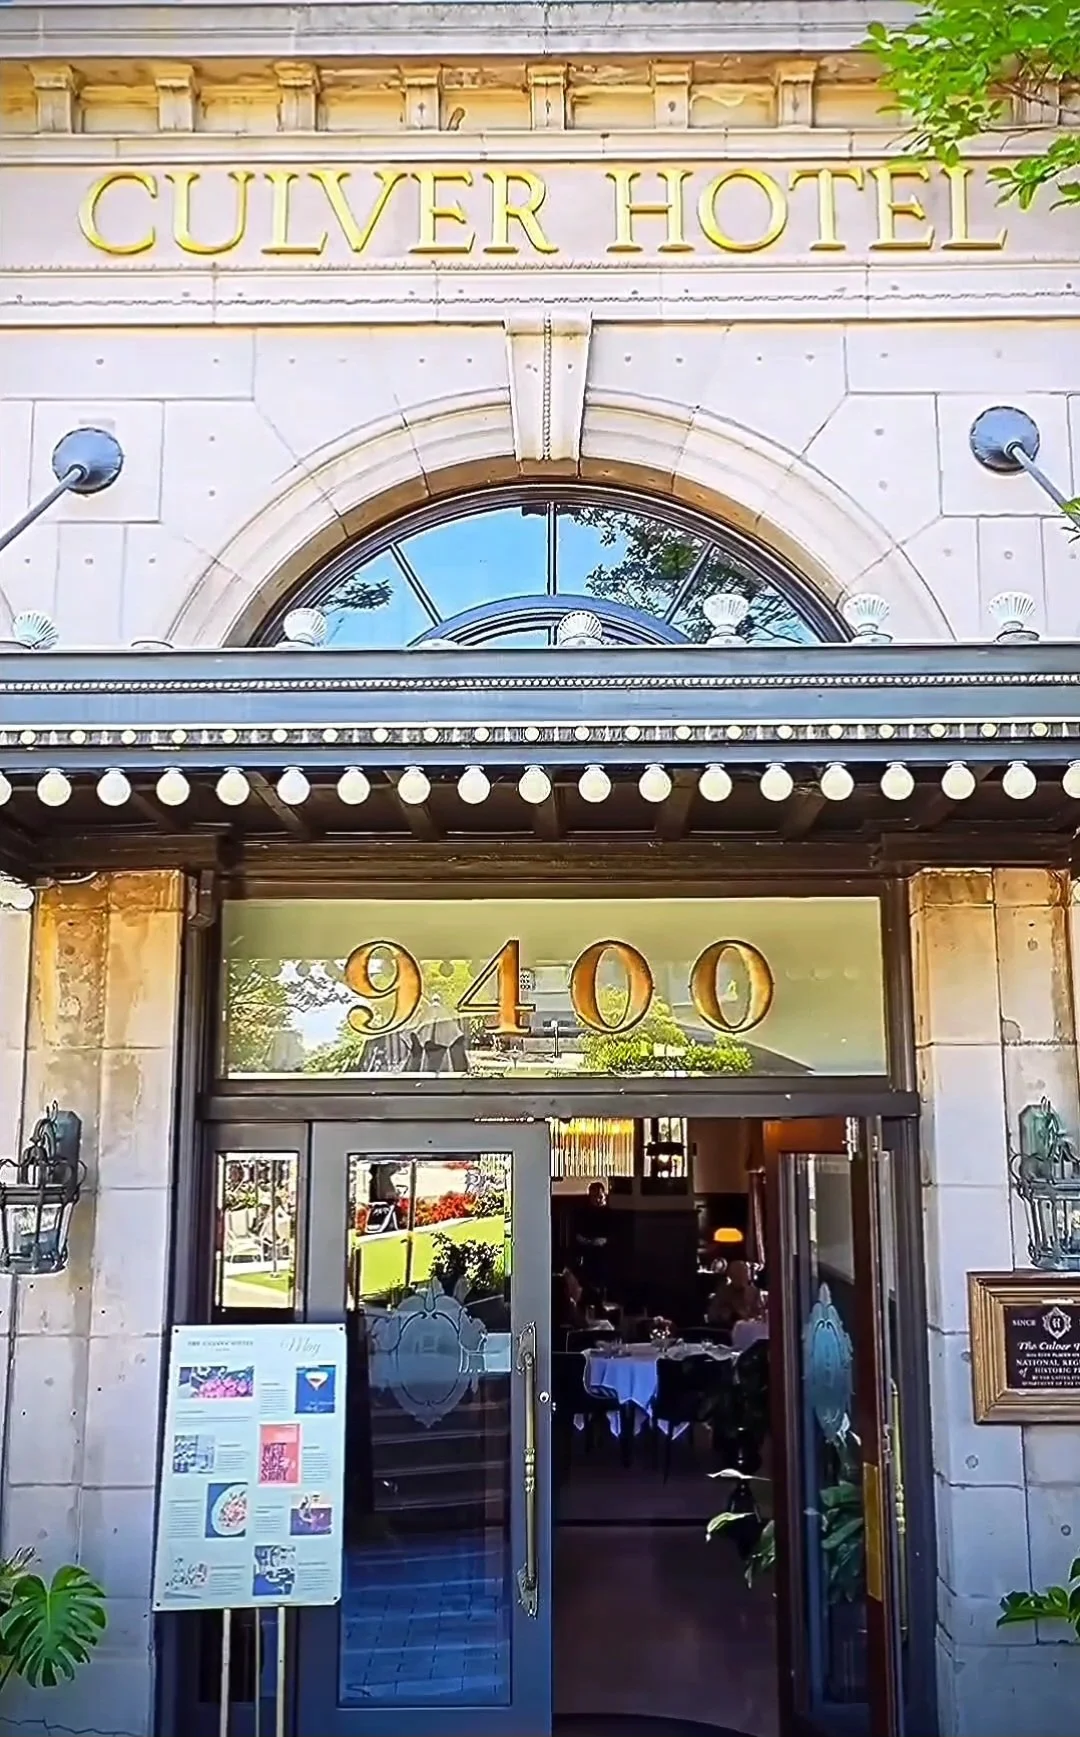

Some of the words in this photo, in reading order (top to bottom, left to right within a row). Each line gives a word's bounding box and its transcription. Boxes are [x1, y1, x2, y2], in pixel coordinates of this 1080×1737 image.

[78, 169, 559, 254] CULVER
[605, 165, 1008, 253] HOTEL
[344, 938, 775, 1035] 9400
[1039, 1340, 1071, 1350] Culver
[1019, 1367, 1028, 1378] of
